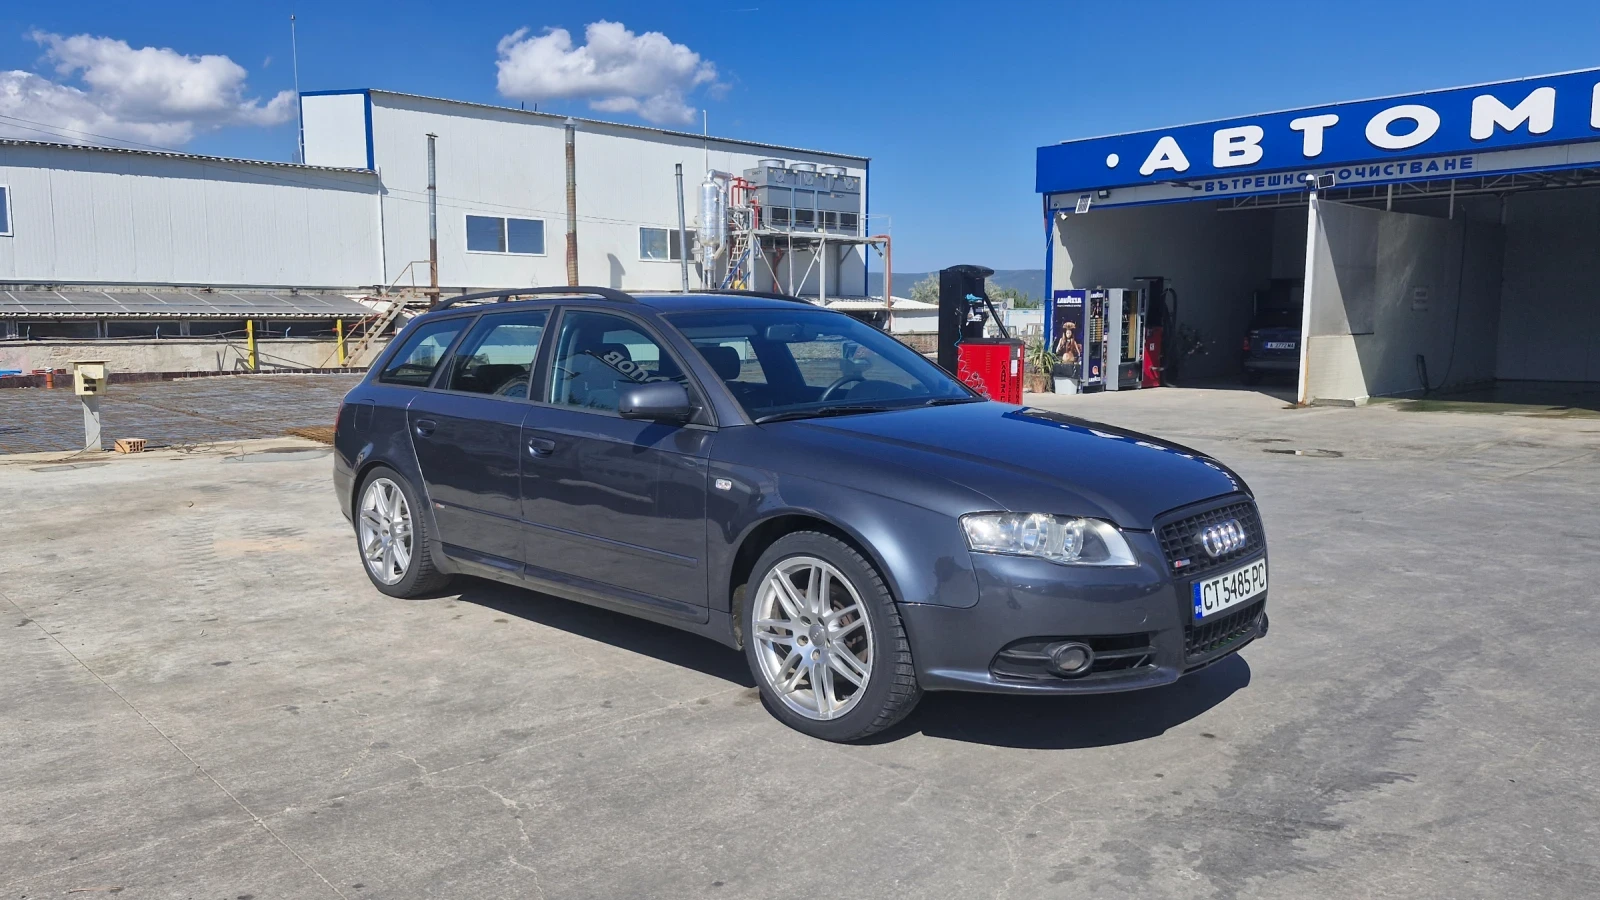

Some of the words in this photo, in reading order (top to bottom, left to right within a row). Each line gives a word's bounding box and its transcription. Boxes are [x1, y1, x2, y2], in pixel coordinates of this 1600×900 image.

[1139, 82, 1600, 177] АВТОМ
[1325, 156, 1474, 183] ОЧИСТВАНЕ
[1203, 581, 1220, 611] CT
[1223, 568, 1251, 604] 5485
[1251, 562, 1265, 592] PC
